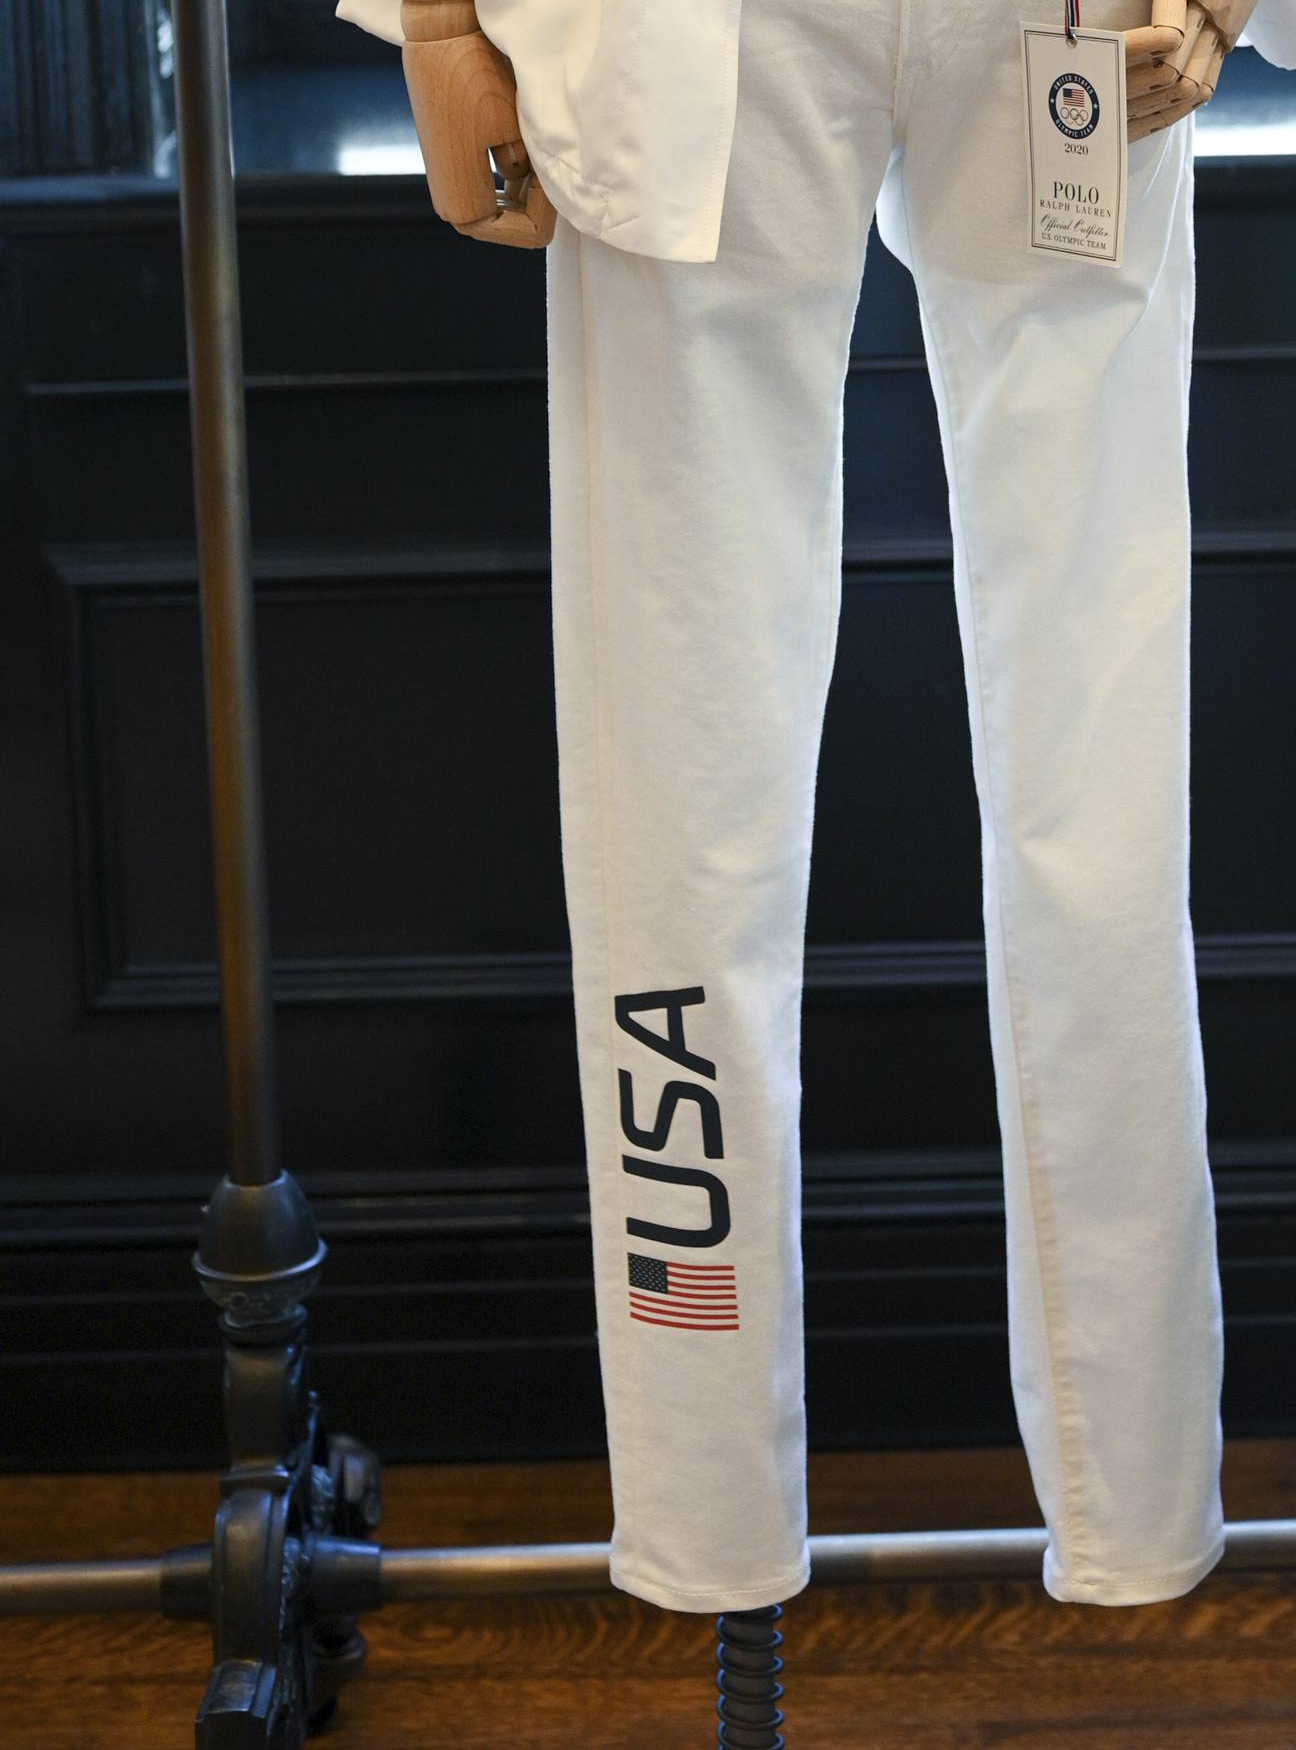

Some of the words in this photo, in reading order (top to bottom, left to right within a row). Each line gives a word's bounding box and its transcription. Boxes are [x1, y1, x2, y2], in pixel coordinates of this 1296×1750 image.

[1053, 74, 1073, 91] UNITED
[1074, 74, 1094, 95] STATES
[1055, 118, 1079, 138] OLYMPIC
[1080, 122, 1094, 138] TEAM
[1064, 143, 1089, 156] 2020
[1053, 181, 1100, 205] POLO
[1040, 199, 1071, 212] RALPH
[1075, 204, 1112, 218] LAUREN
[1040, 213, 1071, 232] Official
[1073, 219, 1109, 238] Outfitter
[1041, 232, 1052, 241] U.S.
[1054, 234, 1085, 247] OLYMPIC
[1087, 239, 1107, 250] TEAM
[614, 985, 731, 1248] USA
